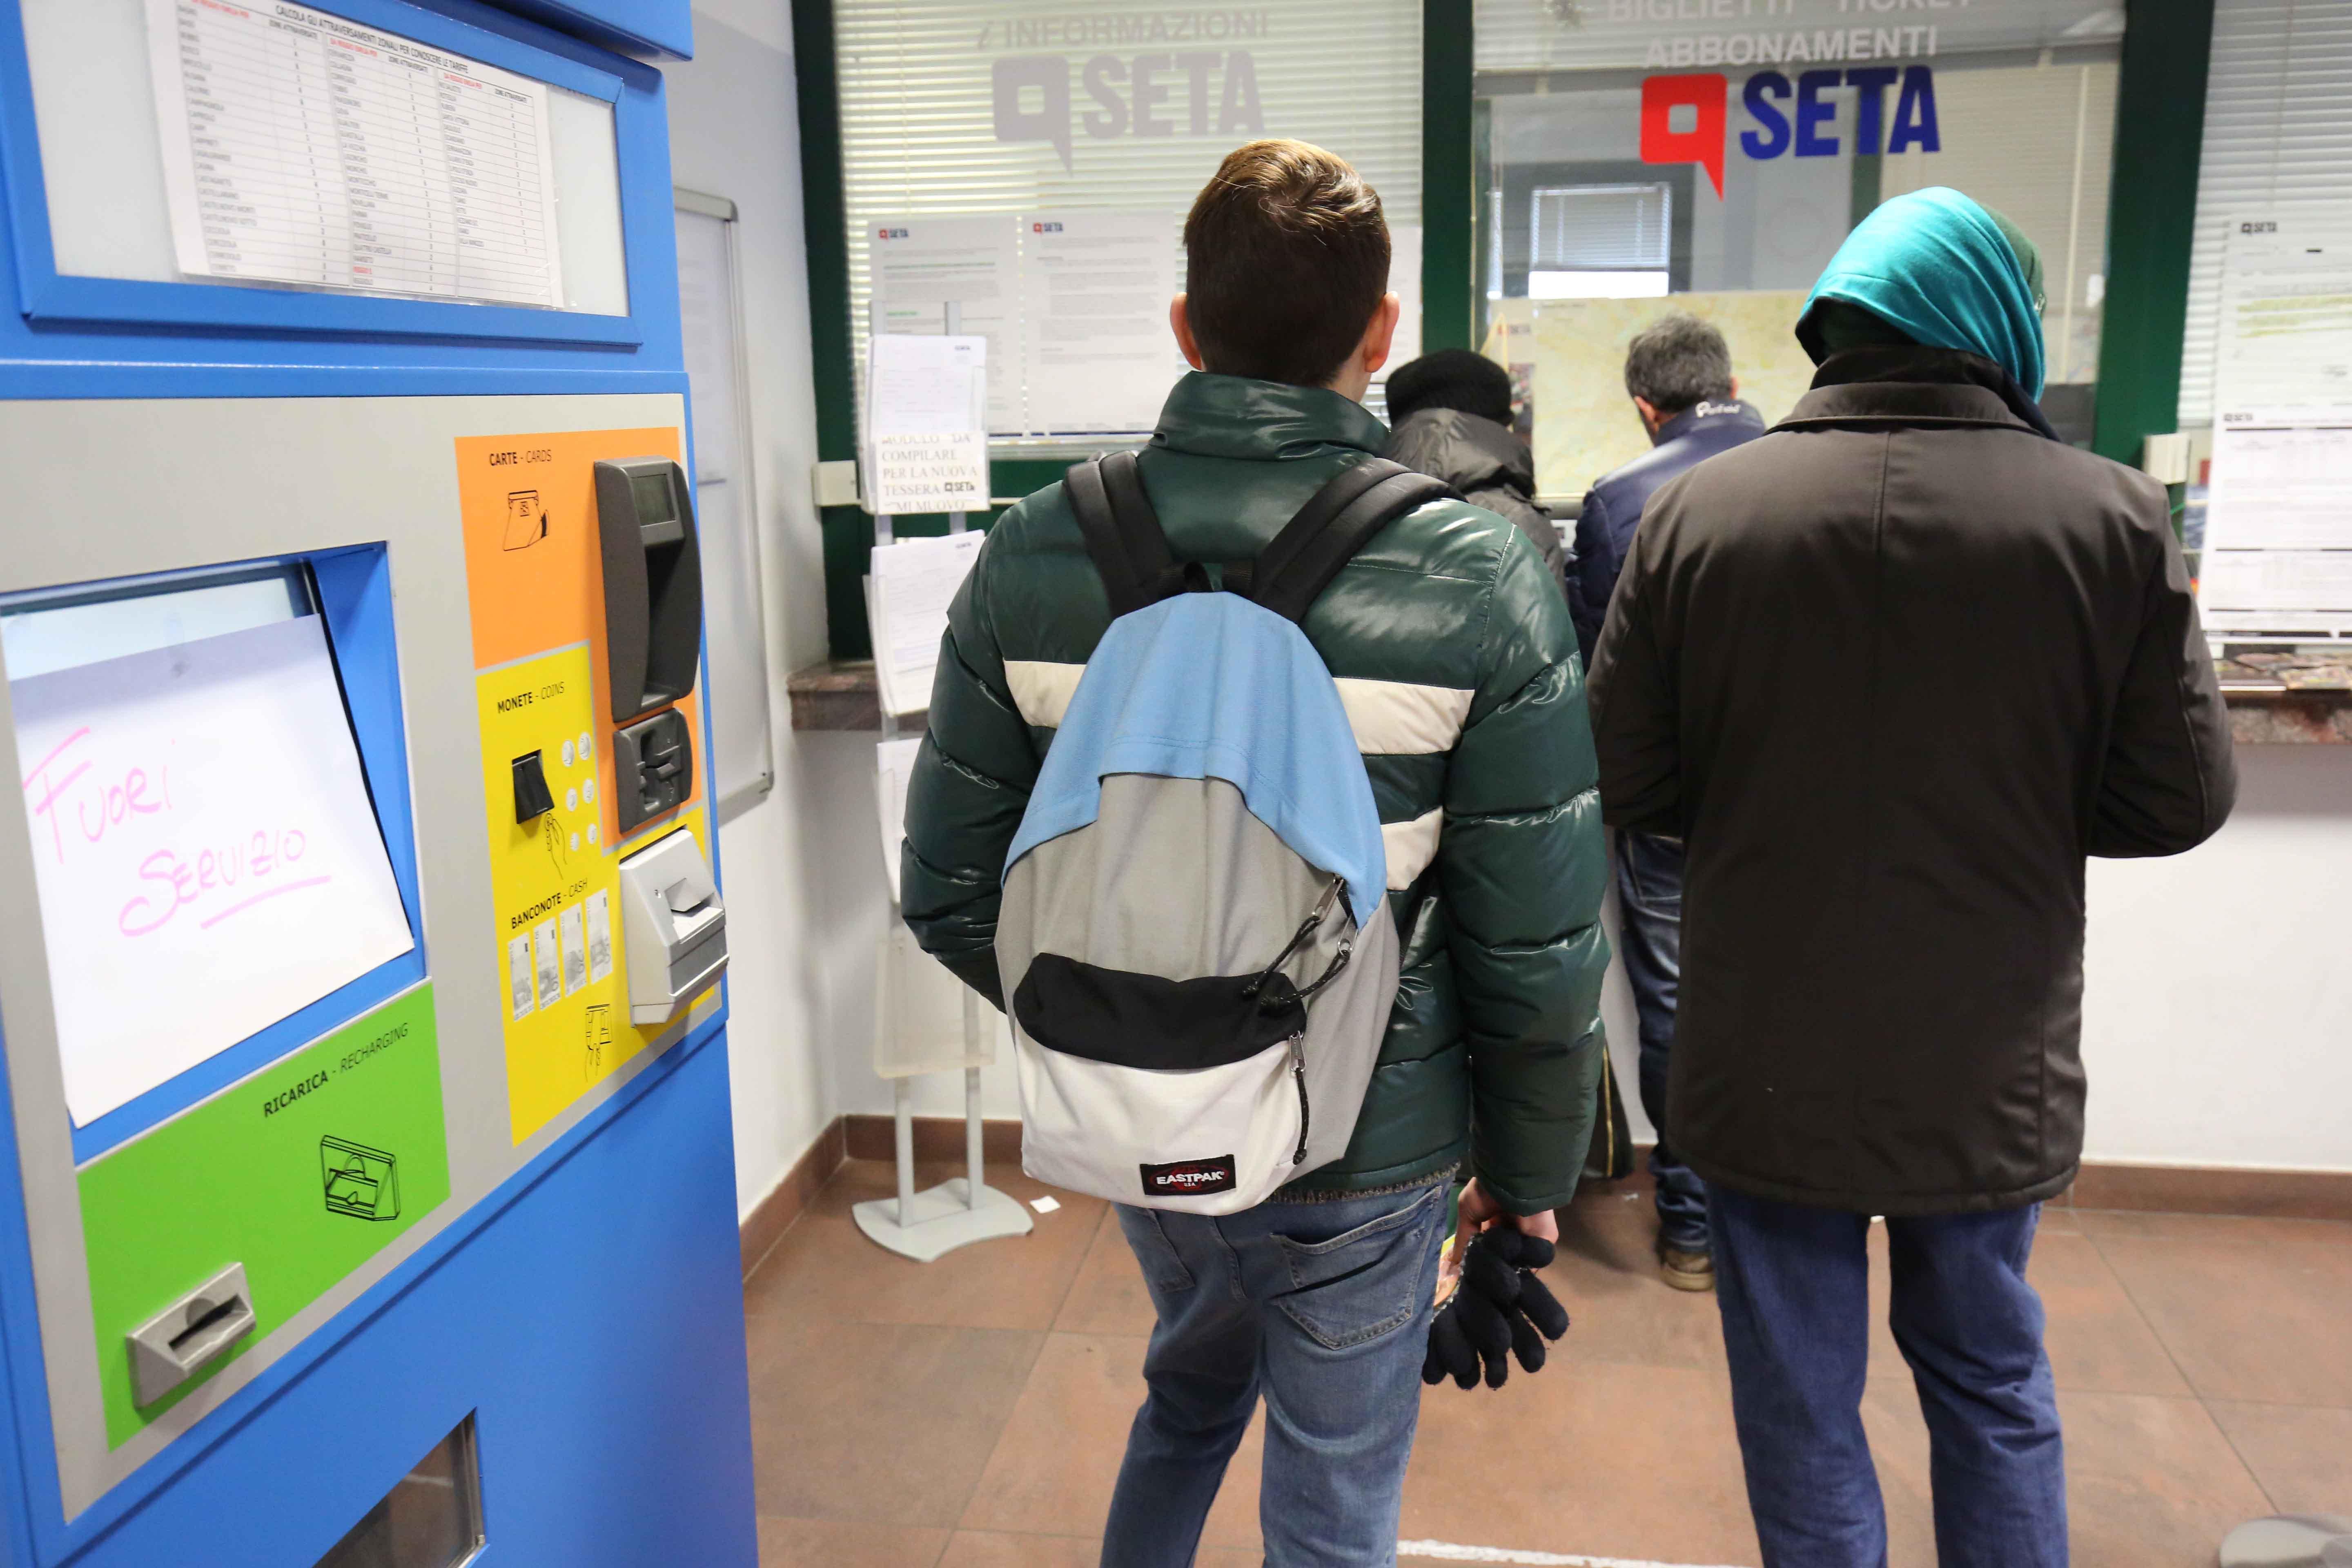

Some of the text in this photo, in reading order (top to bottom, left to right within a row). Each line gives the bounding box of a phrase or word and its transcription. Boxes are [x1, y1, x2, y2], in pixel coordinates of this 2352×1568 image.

[276, 5, 305, 22] CALCOLA
[400, 45, 409, 54] PER
[1005, 10, 1267, 47] INFORMAZIONI
[1645, 26, 1938, 68] ABBONAMENTI
[1081, 51, 1265, 139] SETA
[1739, 65, 1940, 159] SETA
[490, 452, 517, 466] CARTE
[526, 449, 552, 463] CARDS
[882, 449, 957, 461] COMPILARE
[883, 465, 978, 479] PER LA NUOVA
[883, 483, 940, 496] TESSERA
[497, 691, 533, 714] MONETE
[541, 681, 565, 700] COINS
[511, 893, 561, 930] BANCONOTE
[569, 877, 588, 898] CASH
[263, 1070, 329, 1118] RICARICA
[341, 1022, 408, 1073] RECHARGING
[1156, 1171, 1224, 1185] EASTPAK
